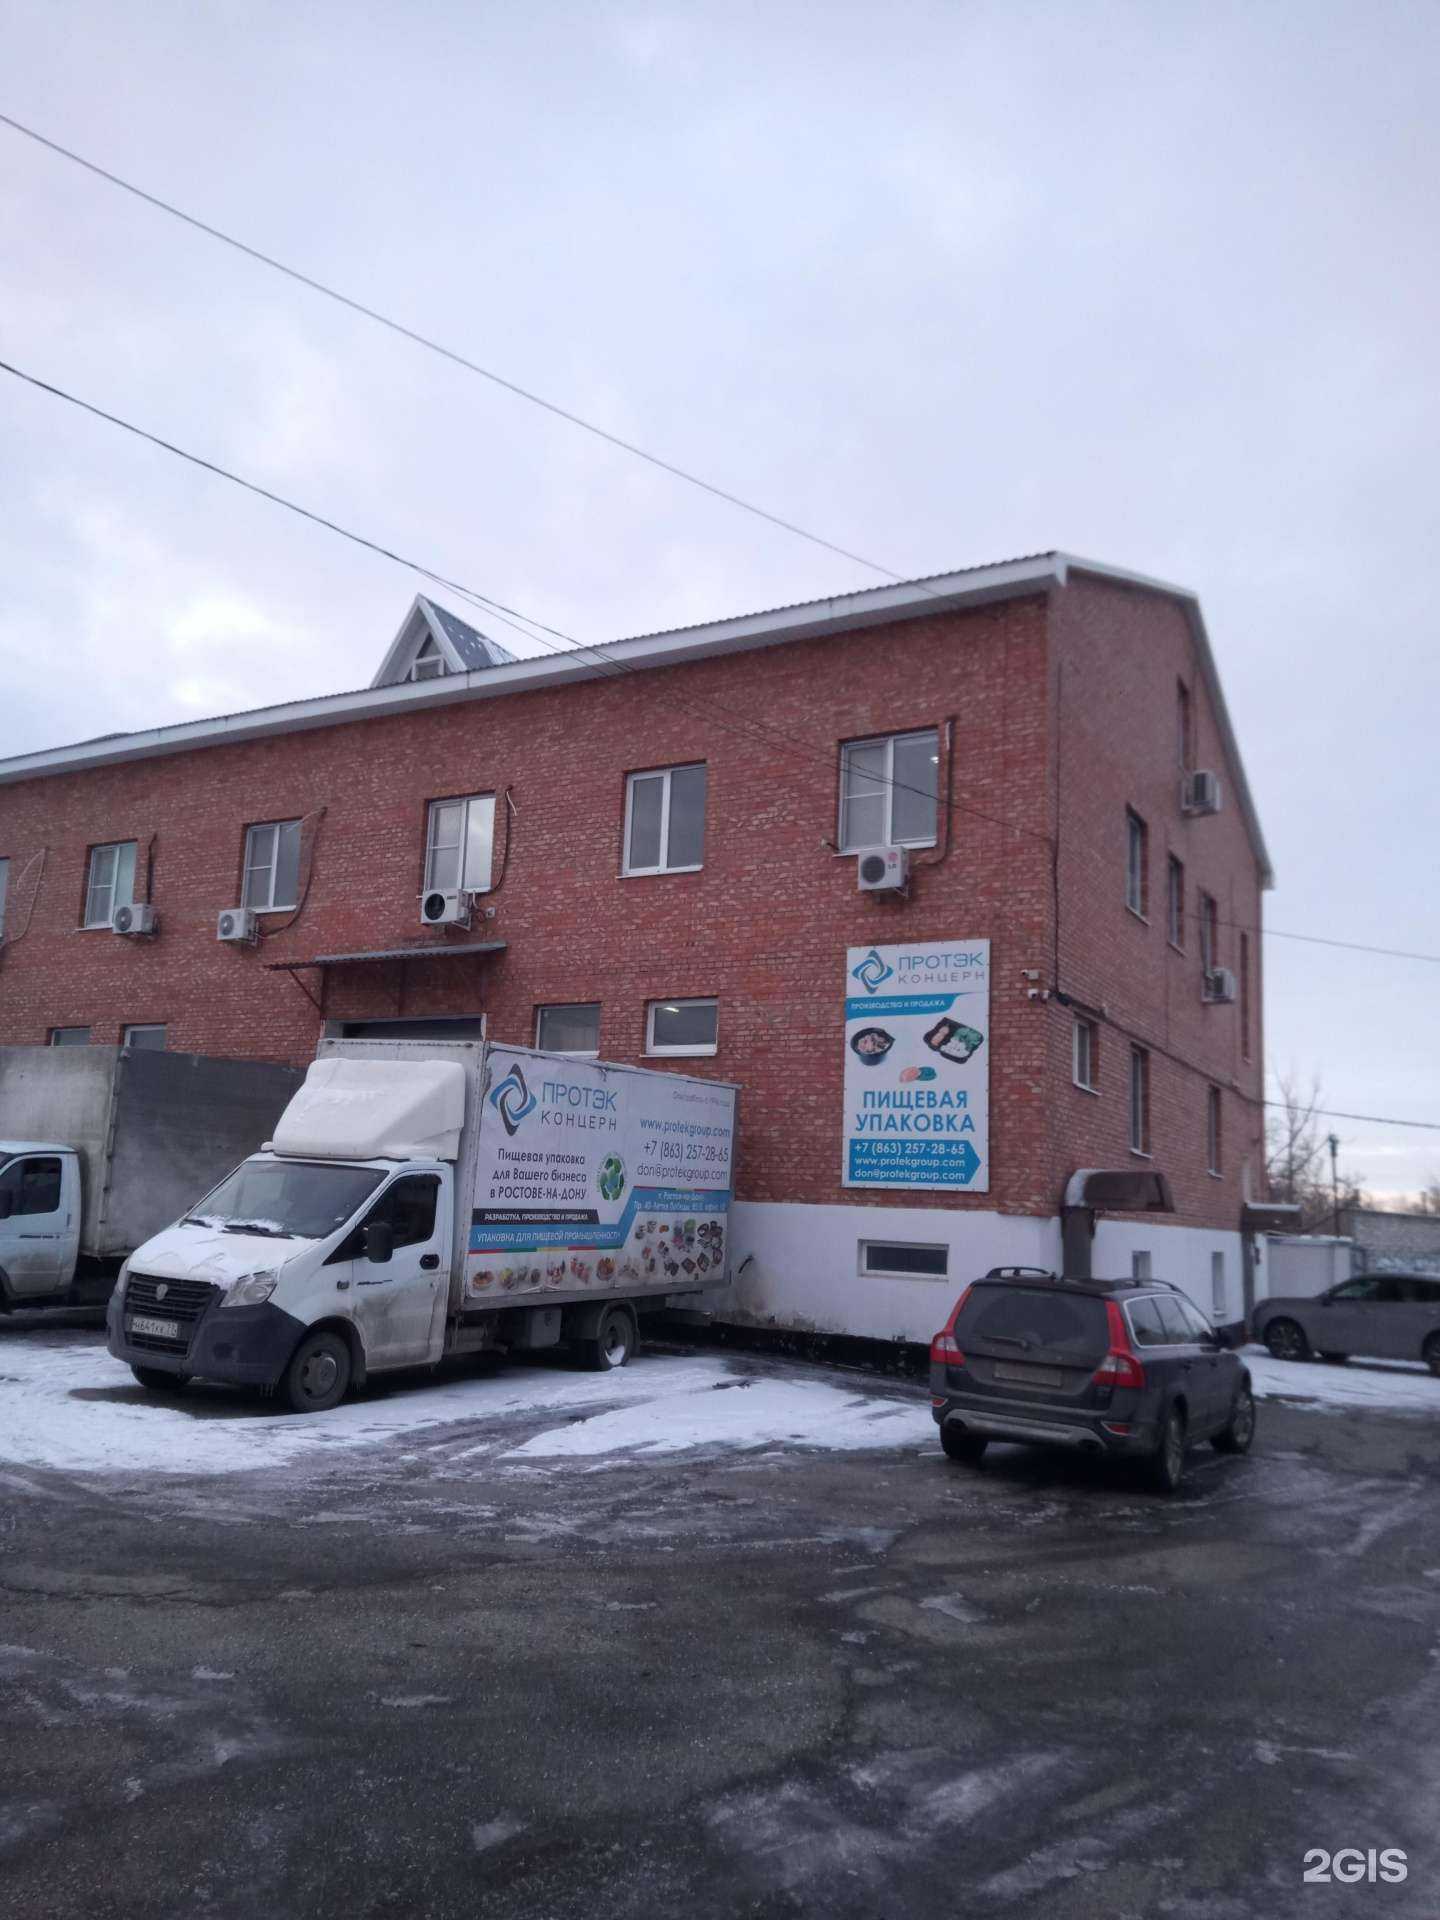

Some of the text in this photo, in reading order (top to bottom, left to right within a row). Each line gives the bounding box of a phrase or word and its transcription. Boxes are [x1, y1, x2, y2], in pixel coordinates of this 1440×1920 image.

[899, 952, 983, 970] ПРОТЭК
[898, 971, 985, 984] КОНЦЕРН
[851, 1001, 903, 1009] ПРОИЗВОДСТВО
[910, 999, 946, 1008] ПРОДАЖА
[542, 1082, 617, 1112] ПРОТЭК
[863, 1090, 967, 1111] ПИЩЕВАЯ
[541, 1110, 617, 1131] КОНЦЕРН
[640, 1119, 730, 1137] www.protekgroup.com
[855, 1113, 975, 1132] УПАКОВКА
[498, 1148, 585, 1165] Пищевая упаковка
[644, 1141, 729, 1162] +7 (863) 257-28-65
[855, 1143, 965, 1155] +7 (863) 257-28-65
[855, 1157, 965, 1167] www.protekgroup.com
[492, 1168, 586, 1182] для Вашего бизнеса
[637, 1163, 728, 1181] don@protekgroup.com
[855, 1169, 965, 1181] don@protekgroup.com
[490, 1186, 587, 1200] в РОСТОВЕ-НА-ДОНУ
[477, 1231, 514, 1242] УПАКОВКА
[515, 1231, 531, 1242] ДЛЯ
[532, 1230, 564, 1241] ПИЩЕВОЙ
